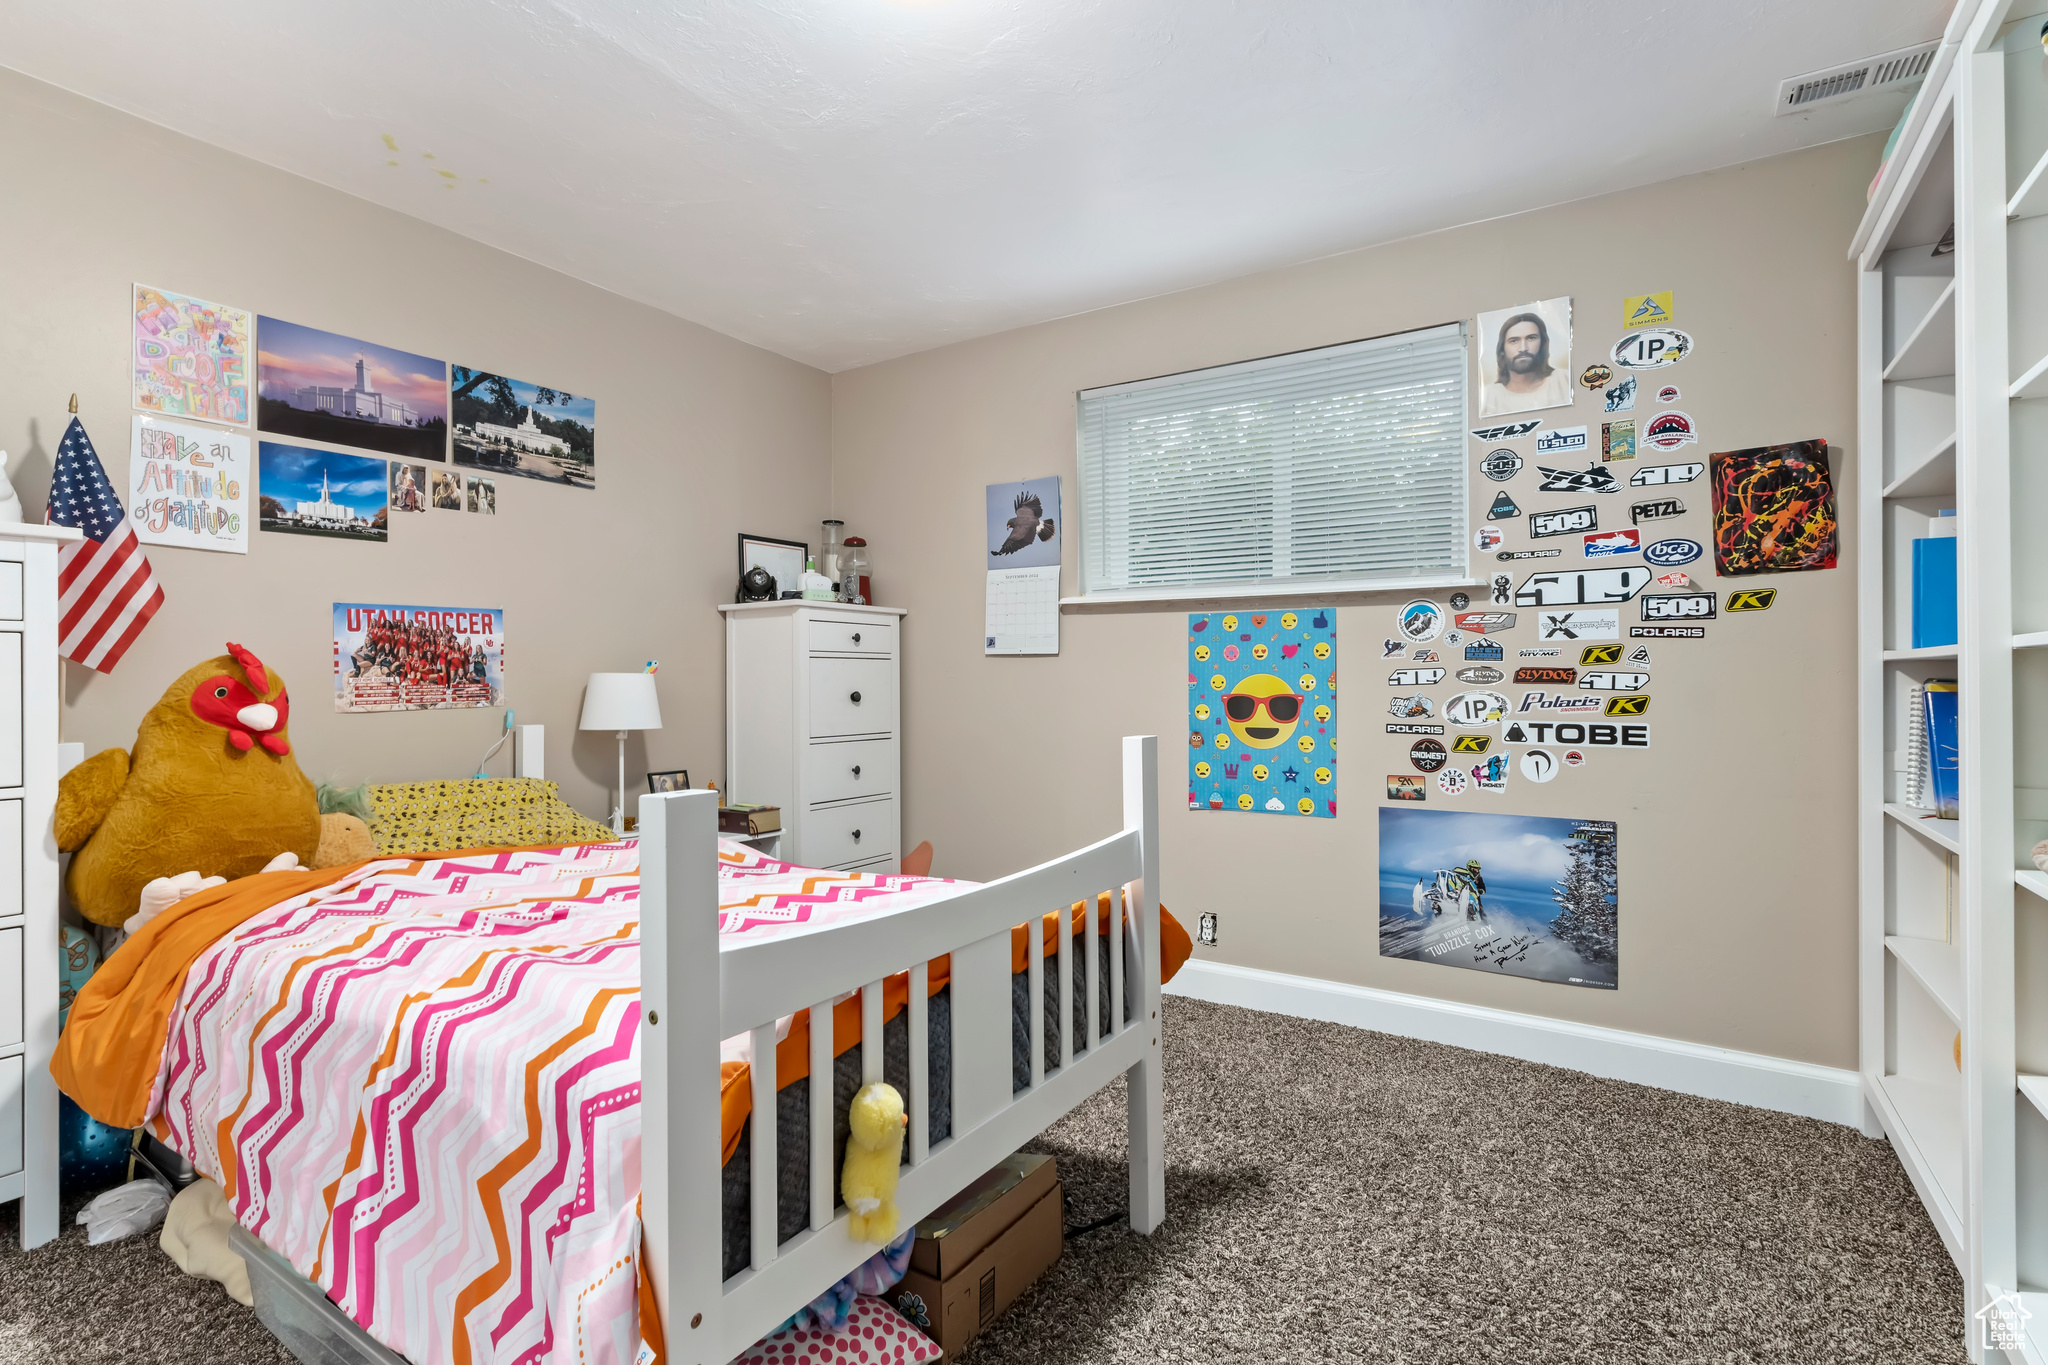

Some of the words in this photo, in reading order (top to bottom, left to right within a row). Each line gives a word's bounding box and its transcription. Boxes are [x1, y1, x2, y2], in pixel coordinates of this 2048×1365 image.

[1629, 316, 1669, 327] SIMMONS
[1638, 338, 1665, 360] IP
[1643, 435, 1660, 443] UTAH
[210, 443, 235, 462] an
[1486, 460, 1516, 471] 509
[137, 460, 240, 501] Attitude
[134, 498, 151, 524] of
[1492, 505, 1515, 513] TOBE
[1631, 500, 1688, 526] PETZL
[1535, 510, 1591, 534] 509
[1513, 550, 1560, 559] POLARIS
[1655, 541, 1689, 556] bca
[1646, 597, 1709, 617] 509
[1729, 593, 1767, 610] K
[346, 608, 406, 632] UTAH
[414, 610, 493, 634] SOCCER
[1461, 613, 1510, 624] SSI
[1631, 627, 1704, 637] POLARIS
[1583, 646, 1621, 663] K
[1474, 670, 1500, 678] SLYDOG
[1517, 669, 1574, 684] SLYDOG
[1390, 704, 1405, 714] YETI
[1391, 698, 1409, 707] UTAH
[1464, 699, 1487, 719] IP
[1517, 692, 1601, 713] Polaris
[1608, 697, 1647, 714] K
[1387, 725, 1444, 734] POLARIS
[1528, 722, 1648, 747] TOBE
[1455, 737, 1488, 751] K
[1411, 751, 1447, 760] SNOWEST
[1440, 770, 1466, 783] CUSTOM
[1440, 783, 1466, 794] WRAPS
[1443, 924, 1471, 940] BRANDON
[1474, 924, 1496, 940] COX
